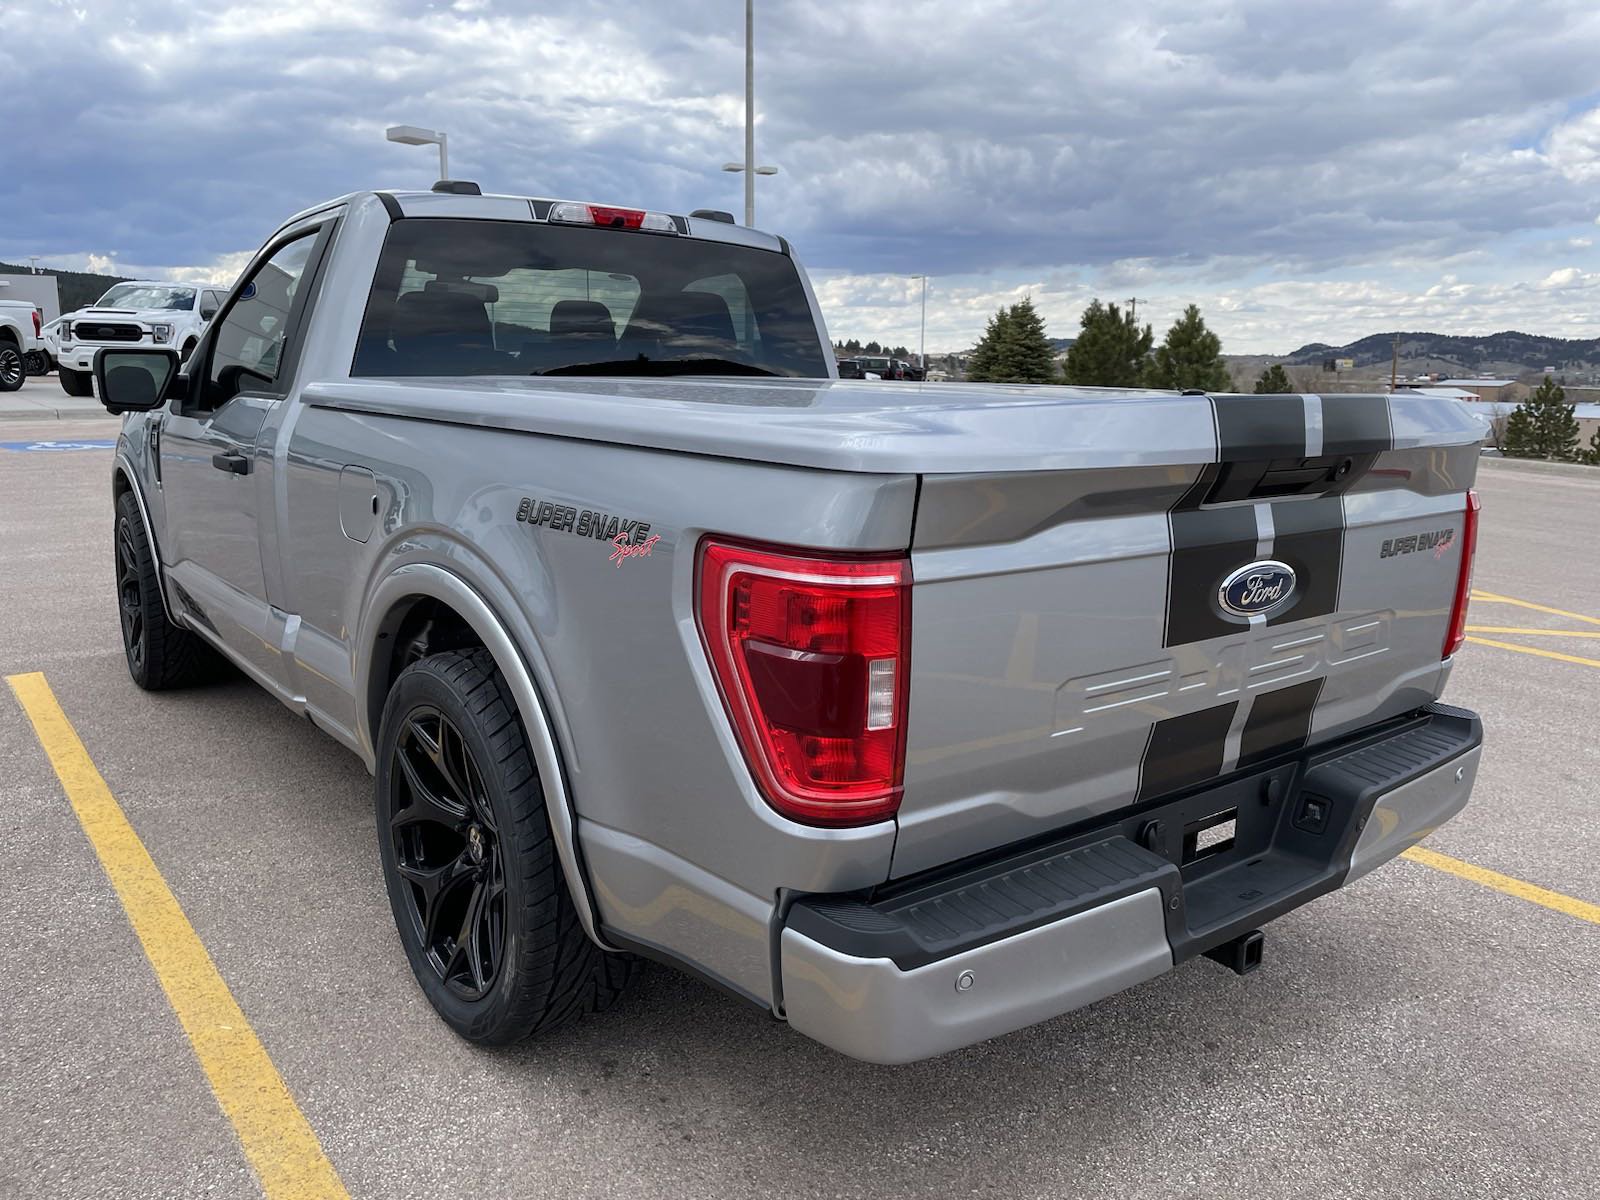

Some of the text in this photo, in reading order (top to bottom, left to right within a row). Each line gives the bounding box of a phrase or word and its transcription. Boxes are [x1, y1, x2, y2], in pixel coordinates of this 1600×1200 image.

[516, 497, 651, 547] SUPER SNAKE
[609, 532, 661, 568] Sport
[1380, 535, 1417, 559] SUPER
[1241, 572, 1284, 605] Ford
